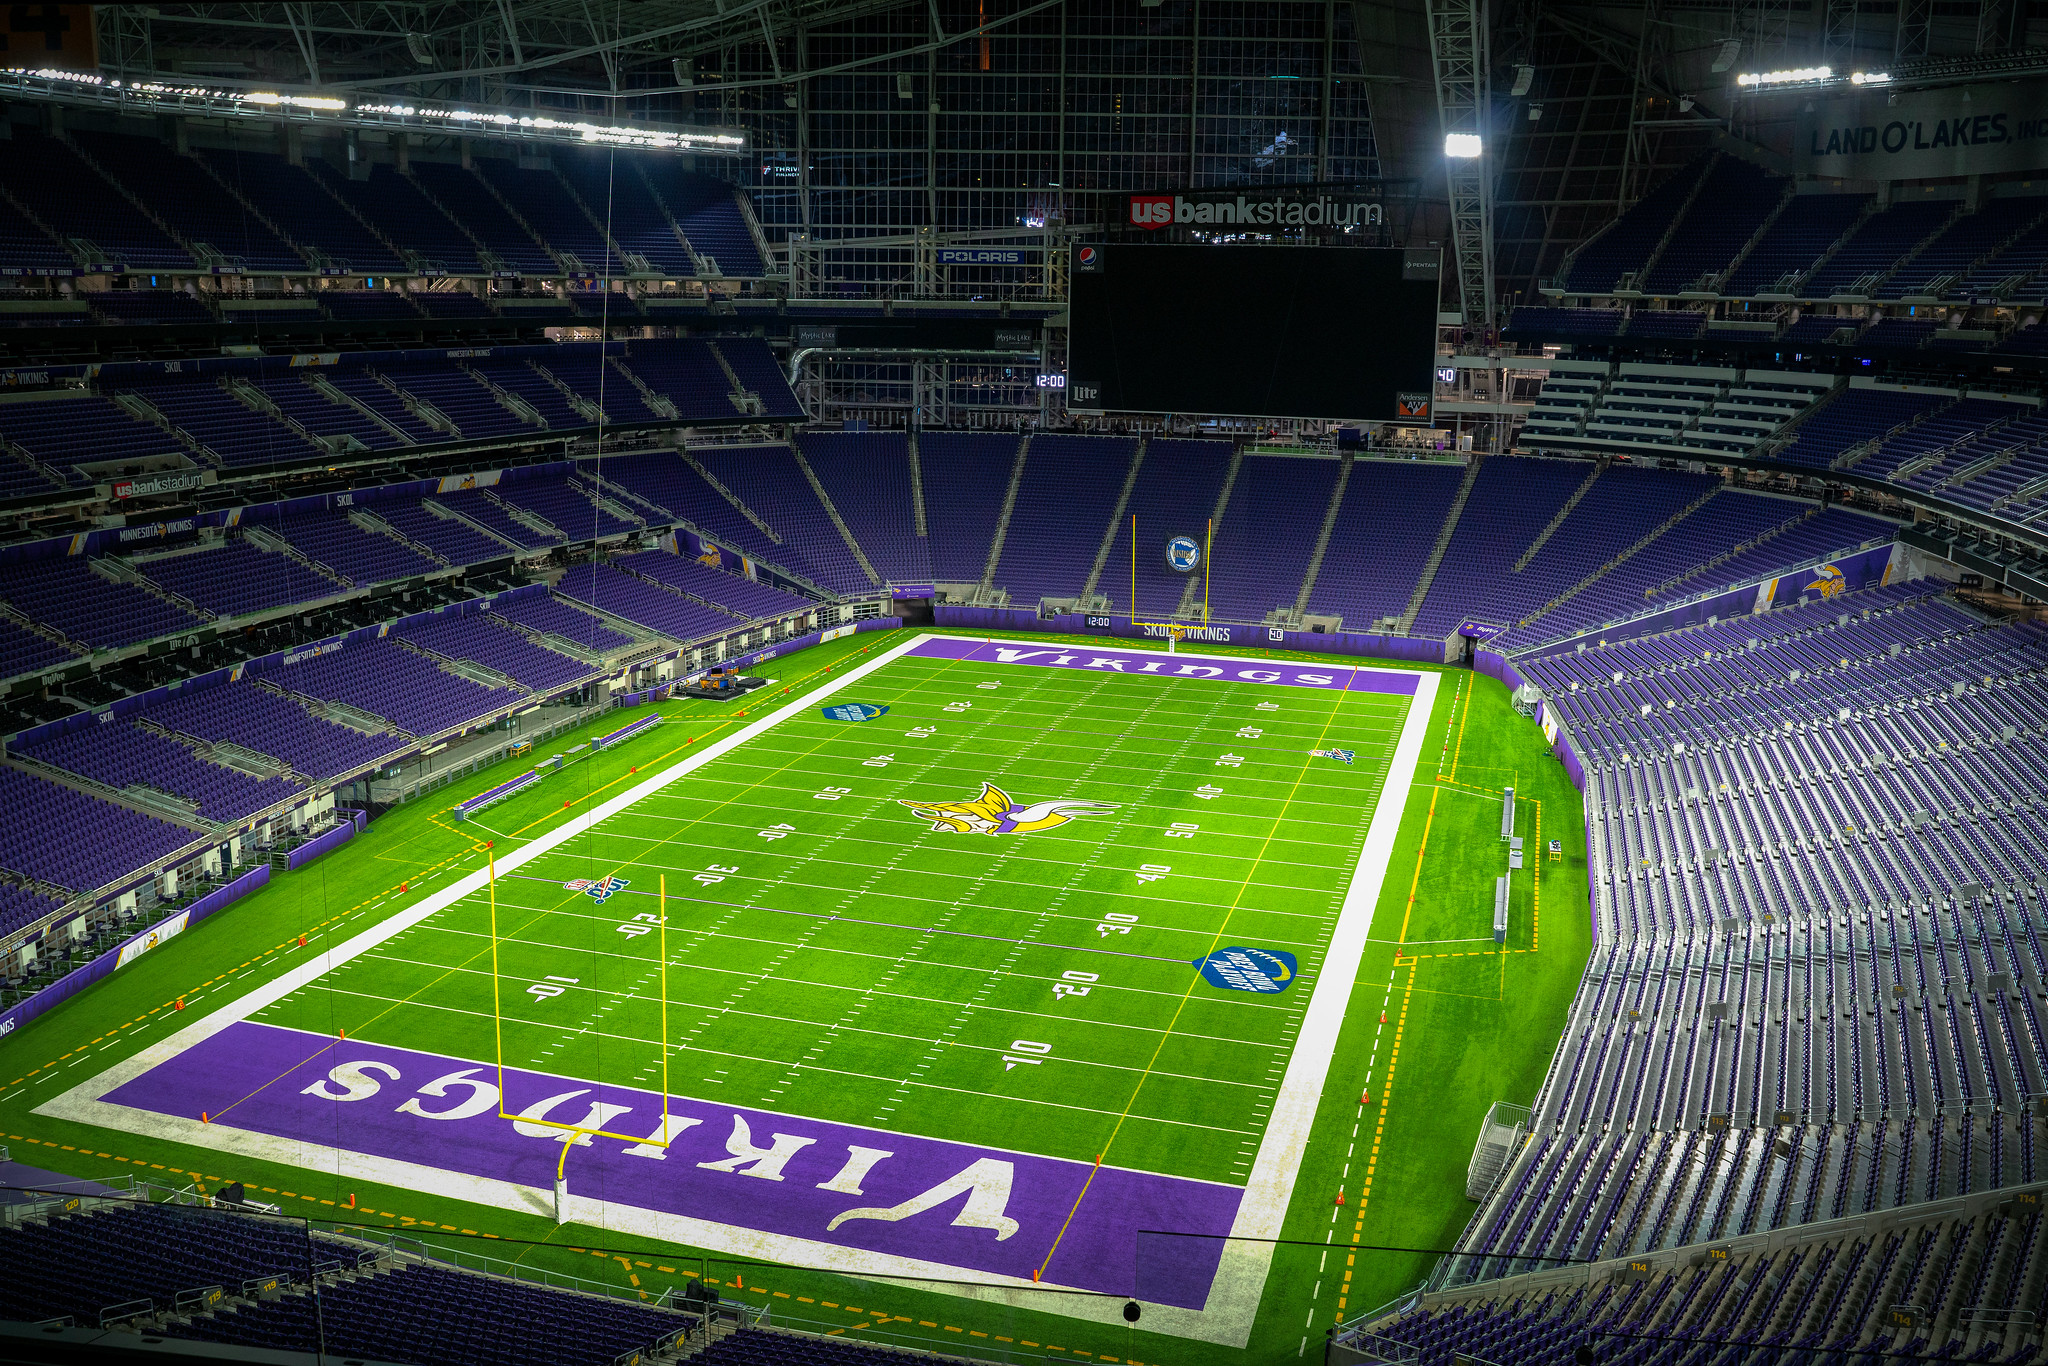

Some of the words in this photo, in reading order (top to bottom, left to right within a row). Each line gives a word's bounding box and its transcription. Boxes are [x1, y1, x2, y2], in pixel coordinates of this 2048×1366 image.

[1811, 126, 1877, 156] LAND
[1882, 113, 2012, 154] O'LAKES,
[943, 251, 1019, 262] POLARIS
[165, 361, 182, 373] SKOL
[18, 371, 49, 385] VIKINGS
[1036, 375, 1065, 387] 12:00
[1438, 369, 1454, 382] 40
[1073, 386, 1098, 402] Lite
[1400, 393, 1427, 401] Andersen
[337, 494, 354, 507] SKOL
[120, 522, 158, 542] MINNESOTA
[166, 519, 192, 534] VIKINGS
[480, 601, 491, 610] SKOL
[1088, 617, 1110, 627] 12:00
[1144, 622, 1170, 637] SKOL
[1185, 625, 1231, 642] VIKINGS
[1270, 630, 1283, 640] 40
[284, 649, 315, 666] MINNESOTA
[322, 641, 343, 654] VIKINGS
[995, 647, 1335, 686] VIKINGS
[1215, 754, 1245, 768] 30
[813, 786, 852, 800] 50
[1193, 785, 1224, 800] 40
[757, 822, 796, 840] 40
[1164, 822, 1200, 839] 50
[692, 864, 739, 883] 30
[1135, 864, 1172, 882] 40
[616, 912, 668, 936] 20
[1096, 912, 1139, 935] 30
[526, 975, 580, 997] 10
[1052, 970, 1099, 997] 20
[1001, 1039, 1053, 1065] 10
[1712, 1117, 1723, 1125] 113
[300, 1060, 1020, 1241] VIKINGS
[65, 1198, 79, 1211] 120
[2018, 1193, 2036, 1205] 114
[1710, 1249, 1726, 1259] 114
[1632, 1262, 1647, 1272] 114
[264, 1280, 276, 1292] 119
[208, 1290, 221, 1304] 119
[1892, 1311, 1911, 1327] 114
